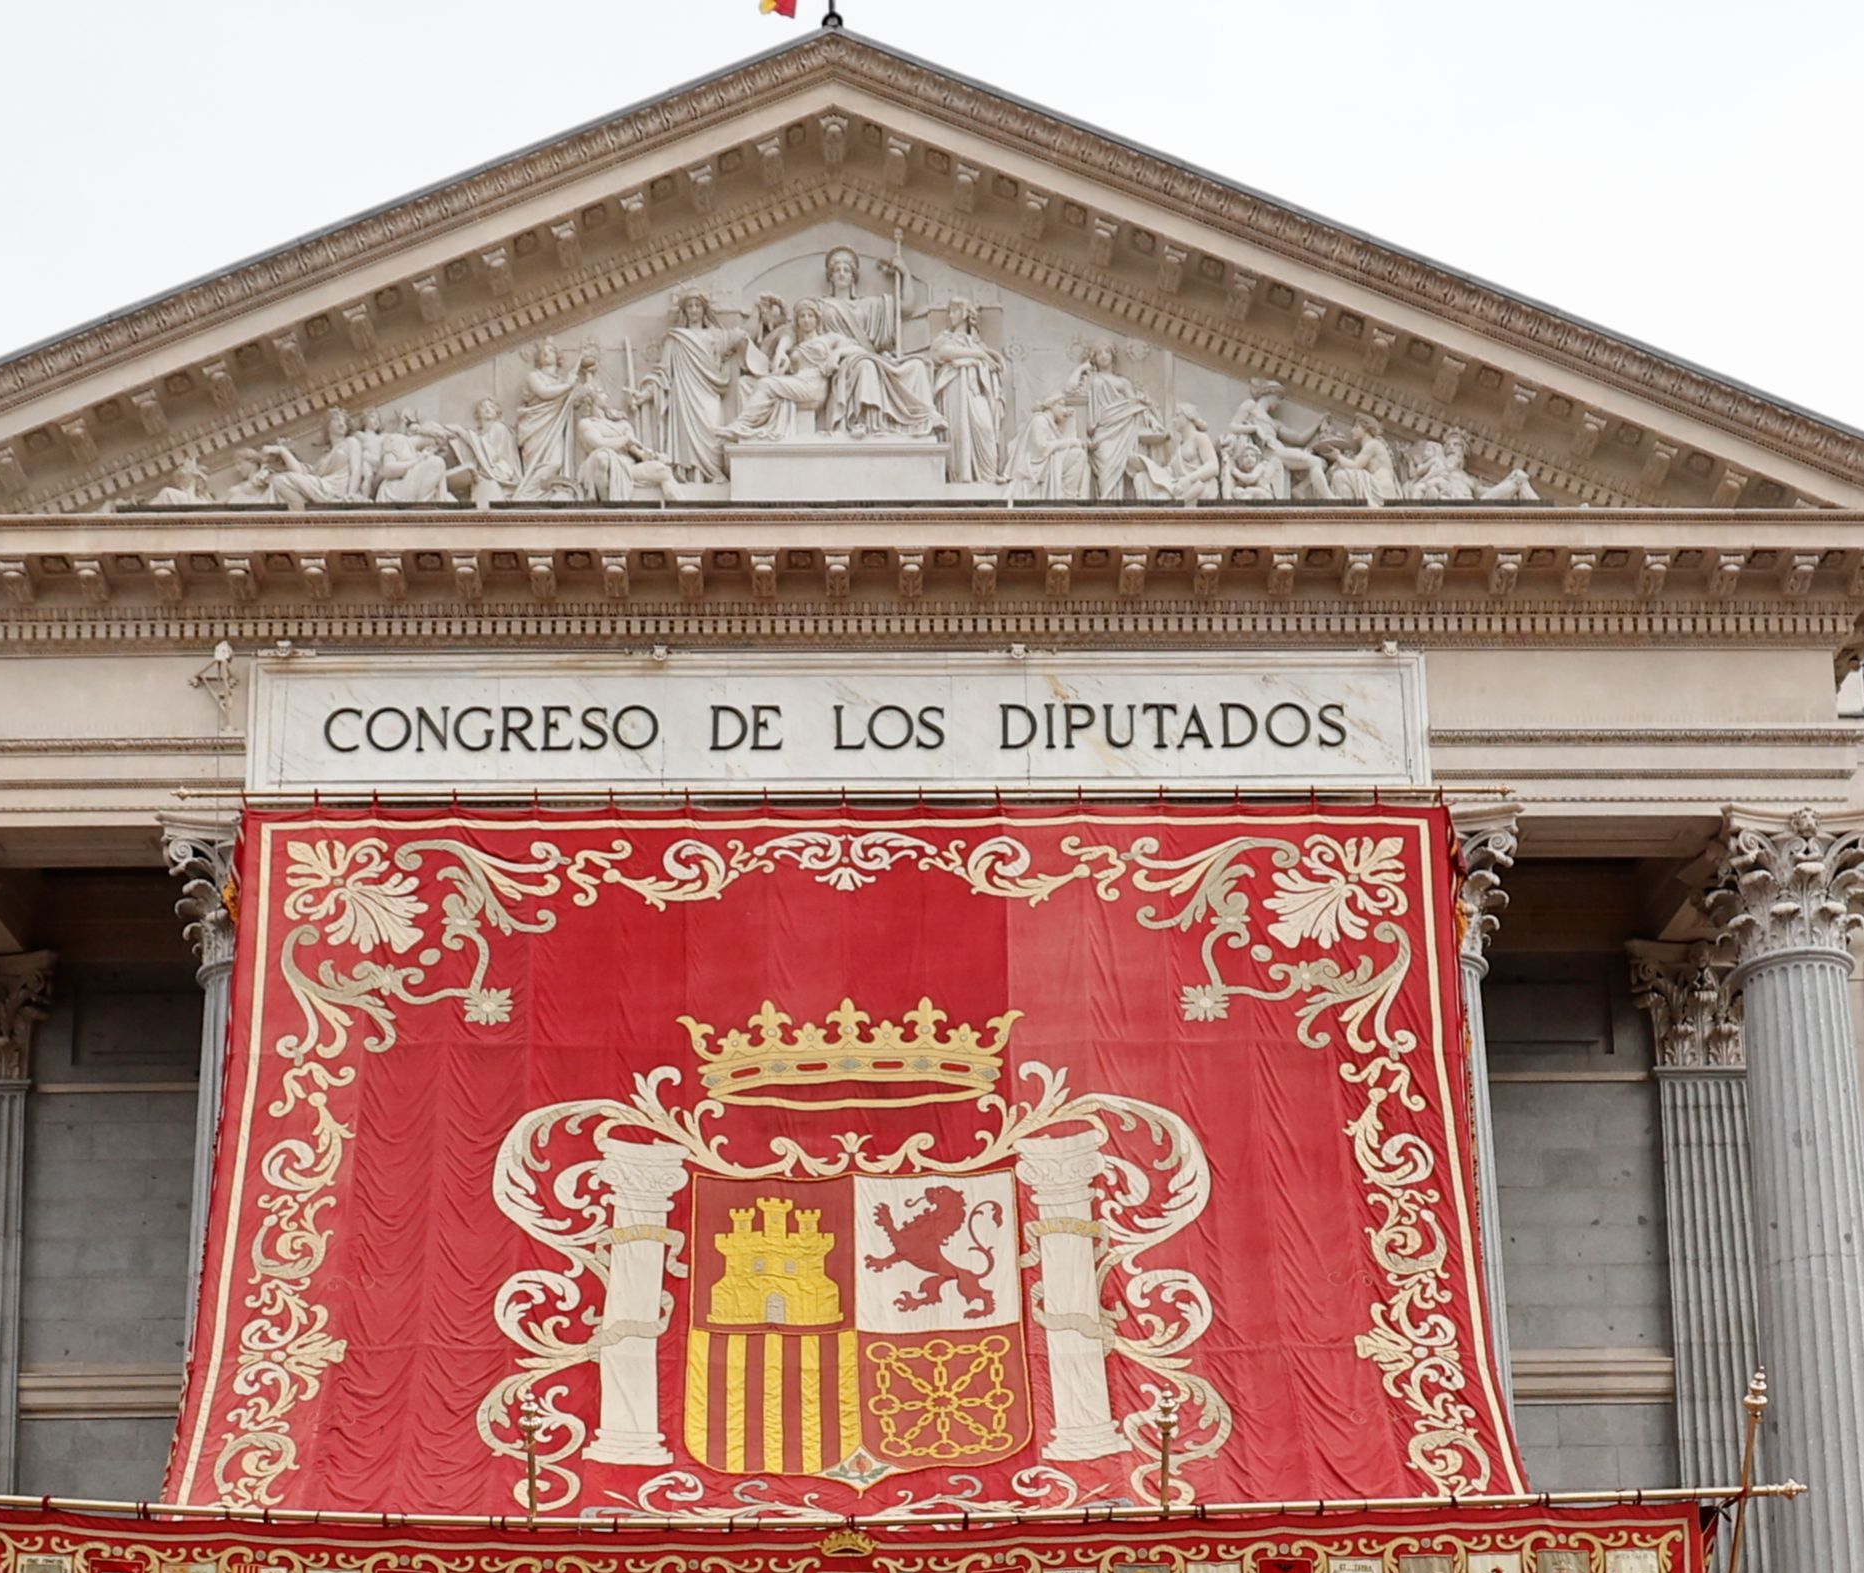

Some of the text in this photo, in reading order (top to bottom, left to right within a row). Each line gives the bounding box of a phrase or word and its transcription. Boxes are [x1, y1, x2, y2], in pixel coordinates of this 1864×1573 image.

[324, 702, 1346, 753] CONGRESO DE LOS DIPUTADOS
